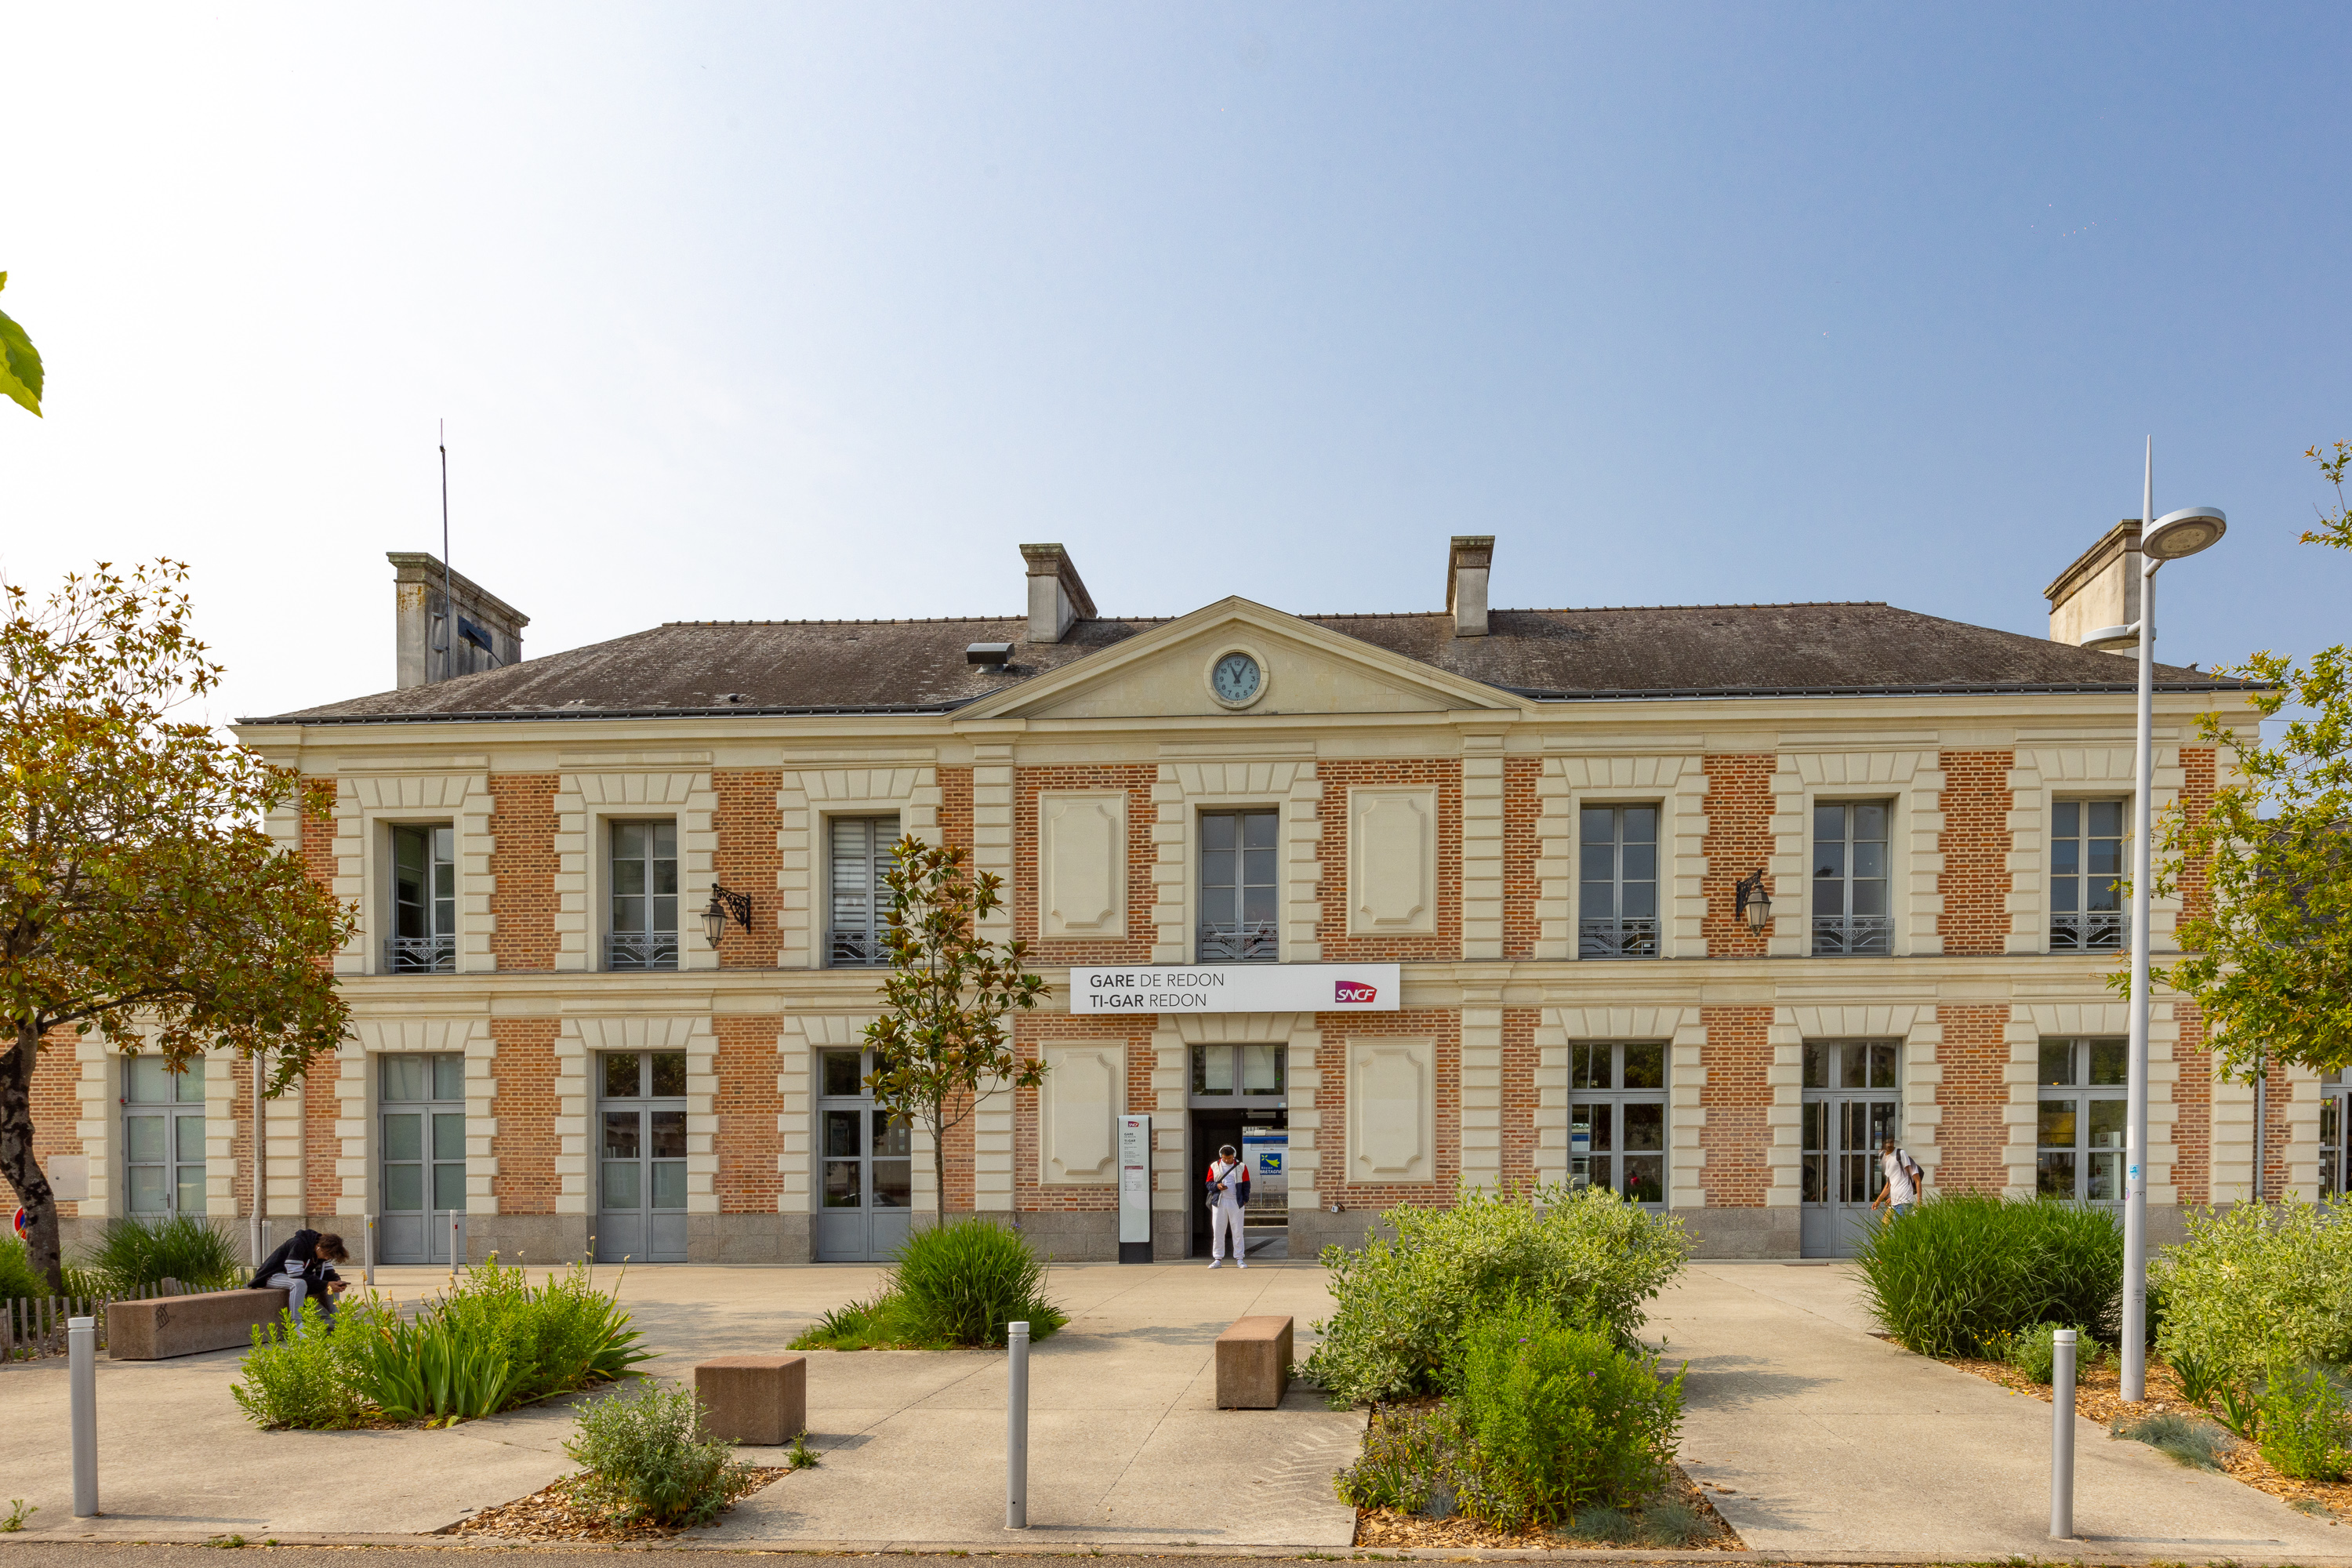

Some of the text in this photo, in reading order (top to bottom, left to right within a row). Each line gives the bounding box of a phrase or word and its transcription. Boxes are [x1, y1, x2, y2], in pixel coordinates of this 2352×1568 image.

[1090, 973, 1224, 988] GARE DE REDON
[1089, 993, 1206, 1007] TI-GAR REDON
[1336, 989, 1375, 1001] SNCF
